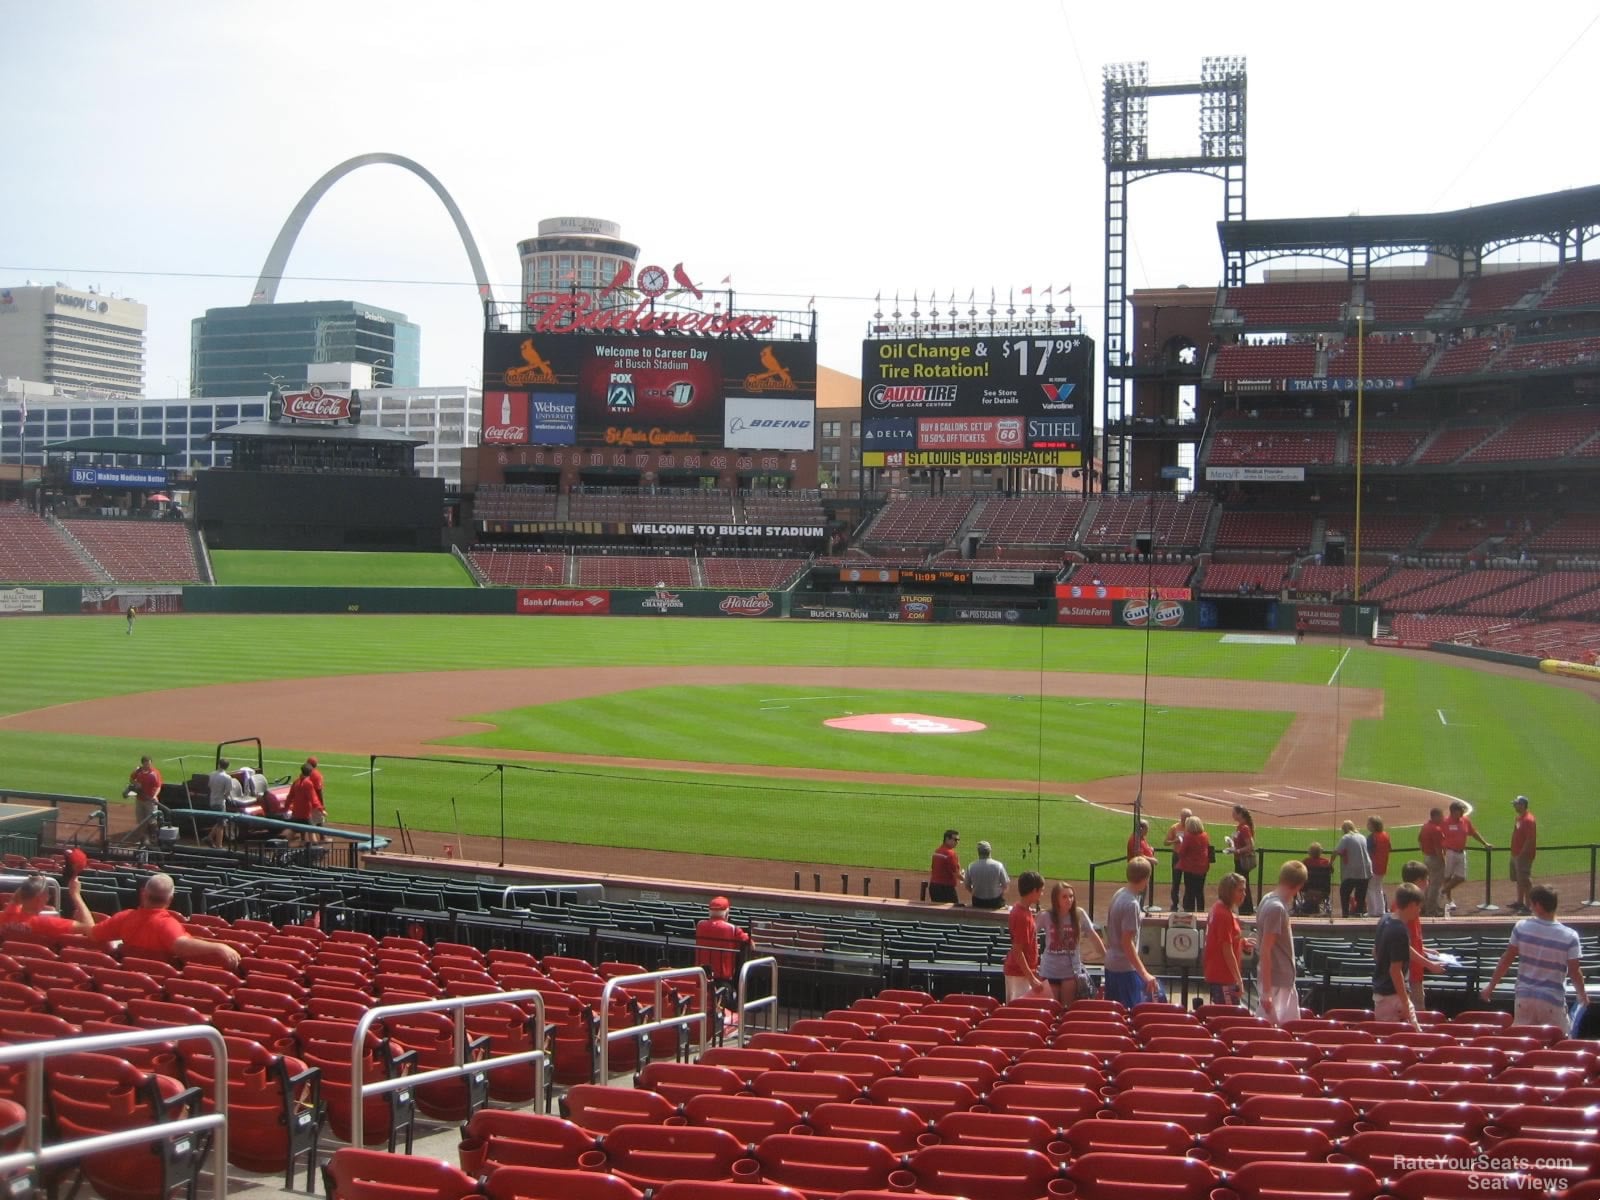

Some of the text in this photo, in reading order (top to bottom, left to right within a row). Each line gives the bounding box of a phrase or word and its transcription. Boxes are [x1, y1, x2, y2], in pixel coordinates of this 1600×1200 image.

[56, 293, 86, 309] KMOV
[526, 292, 777, 333] Budweiser
[887, 320, 1061, 334] WORLD CHAMPIONS
[595, 346, 708, 361] Welcome to Career Day
[879, 342, 988, 360] Oil Change &
[614, 359, 688, 370] at Busch Stadium
[880, 362, 989, 378] Tire Rotation!
[610, 374, 632, 383] FOX
[742, 372, 797, 392] Cardinals
[1294, 380, 1328, 390] THAT'S
[1332, 381, 1339, 390] A
[615, 388, 627, 404] 2
[994, 396, 1019, 404] Details
[534, 402, 576, 413] Webster
[1042, 402, 1074, 410] Valvoline
[750, 418, 811, 428] BOEING
[920, 423, 934, 432] BUY
[970, 422, 982, 432] GET
[984, 422, 992, 432] UP
[1028, 420, 1080, 437] STIFEL
[877, 430, 912, 438] DELTA
[921, 434, 930, 443] TO
[930, 434, 946, 443] 50%
[946, 434, 958, 442] OFF
[1000, 430, 1016, 440] 66
[520, 452, 526, 465] 1
[554, 452, 562, 465] 6
[590, 454, 604, 466] 10
[613, 454, 626, 467] 14
[636, 454, 648, 467] 17
[658, 456, 674, 468] 20
[684, 456, 700, 468] 24
[710, 457, 726, 469] 42
[736, 457, 752, 469] 45
[762, 458, 778, 469] 85
[908, 452, 1059, 464] ST. LOUIS POST-DISPATCH
[76, 471, 94, 482] BJC
[98, 473, 120, 482] Making
[120, 474, 146, 482] Medicine
[1210, 471, 1233, 480] Mercy
[632, 523, 824, 537] WELCOME TO BUSCH STADIUM
[523, 597, 584, 607] Bank of America
[969, 610, 1002, 620] POSTSEASON
[1071, 607, 1110, 616] State Farm
[1124, 608, 1150, 619] Gulf
[1156, 608, 1181, 620] Gulf
